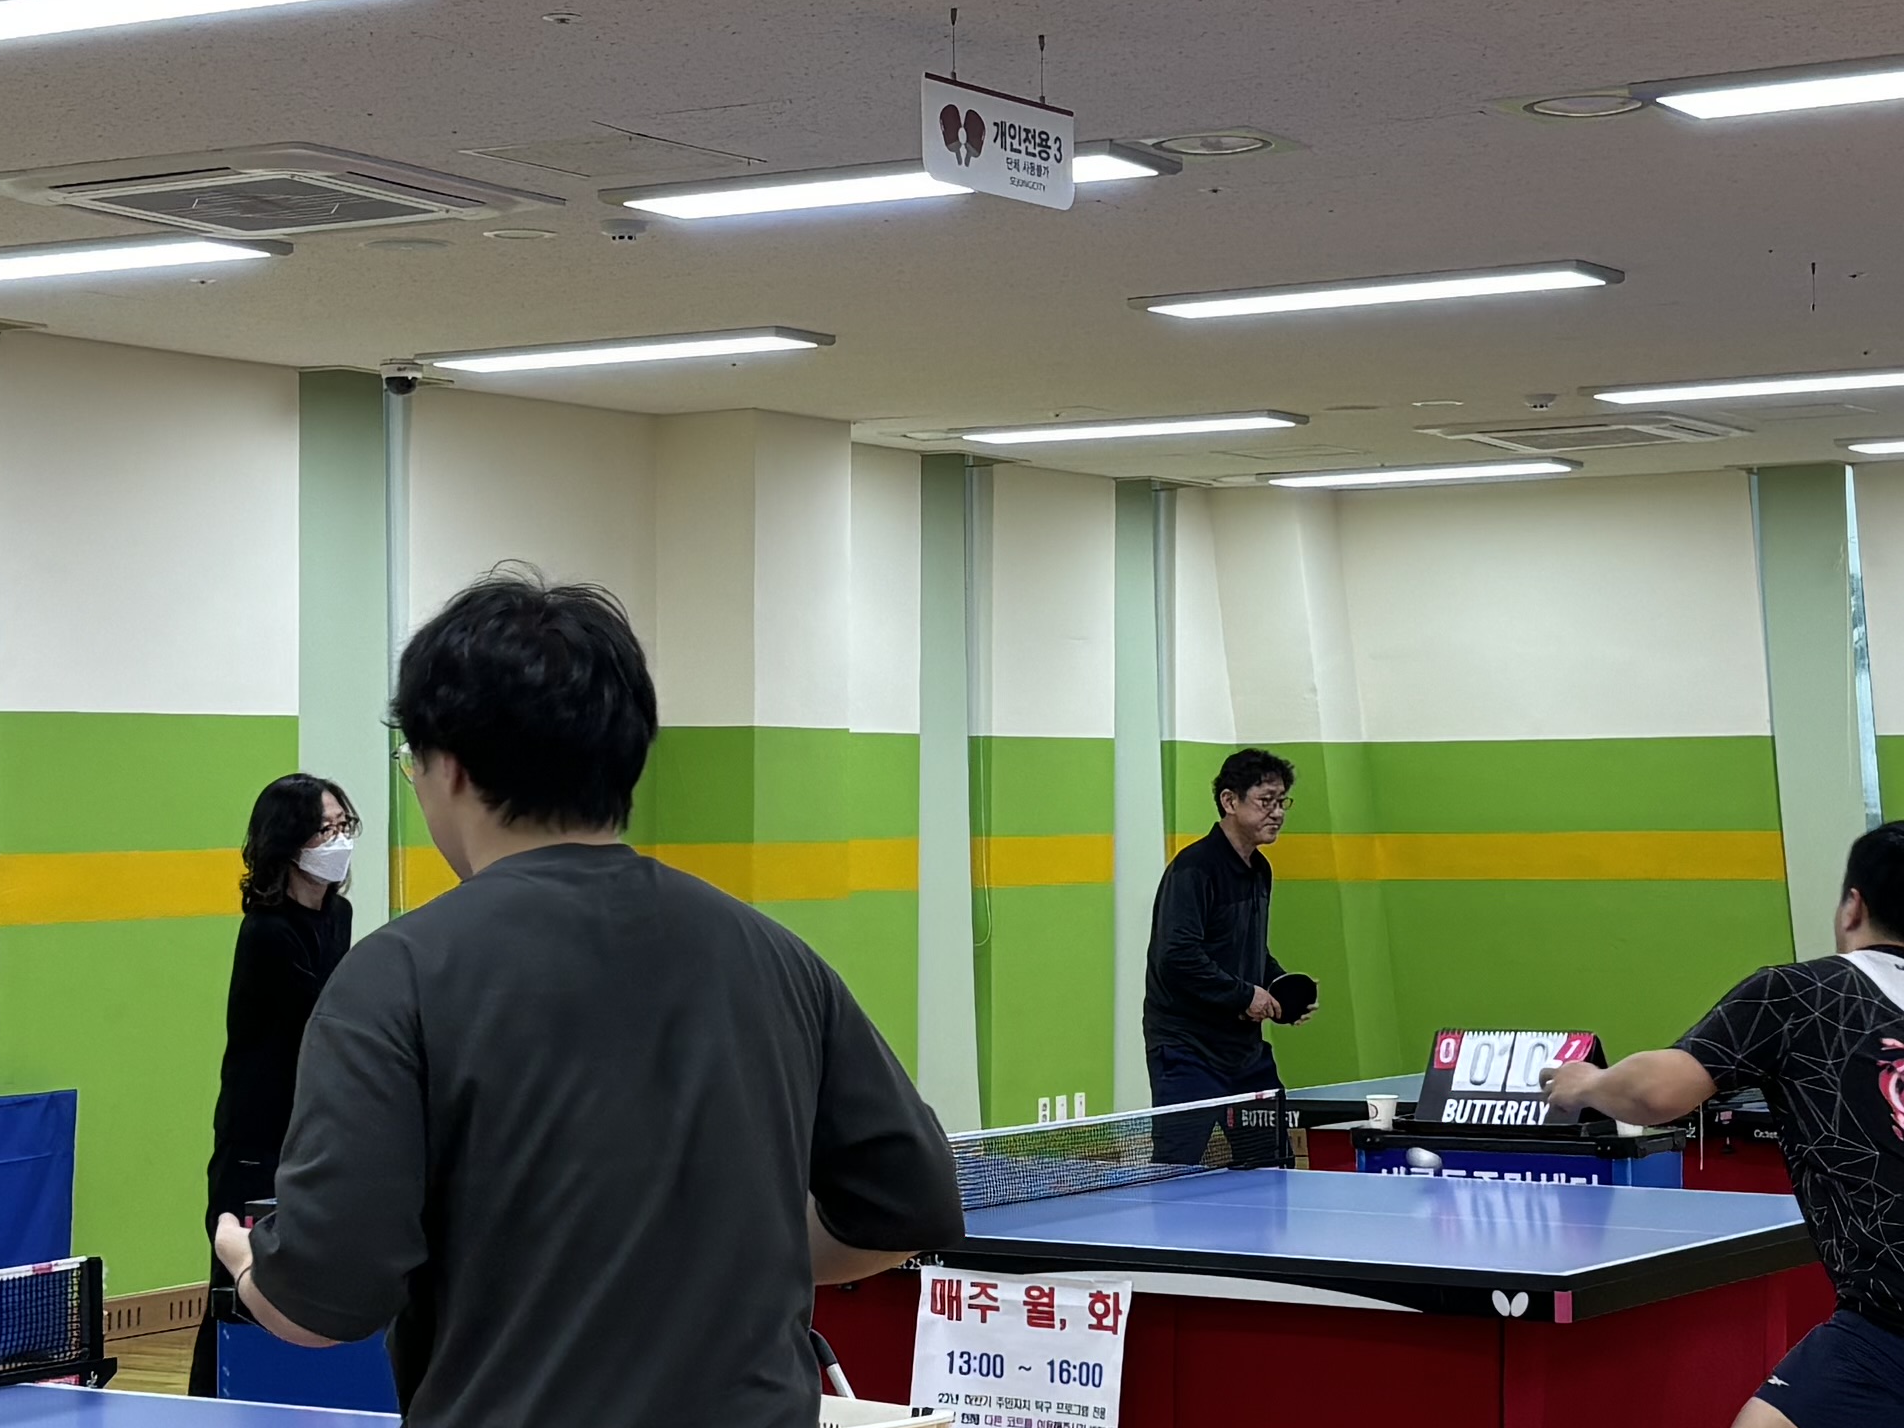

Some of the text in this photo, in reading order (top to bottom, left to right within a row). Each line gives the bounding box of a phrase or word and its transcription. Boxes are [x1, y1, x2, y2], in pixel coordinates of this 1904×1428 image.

[1439, 1038, 1455, 1063] 0
[1564, 1039, 1581, 1059] 1
[1441, 1099, 1550, 1126] BUTTERFLY
[930, 1278, 1123, 1335] 매주 월, 화
[946, 1350, 1005, 1379] 13:00
[1046, 1358, 1104, 1388] 16:00
